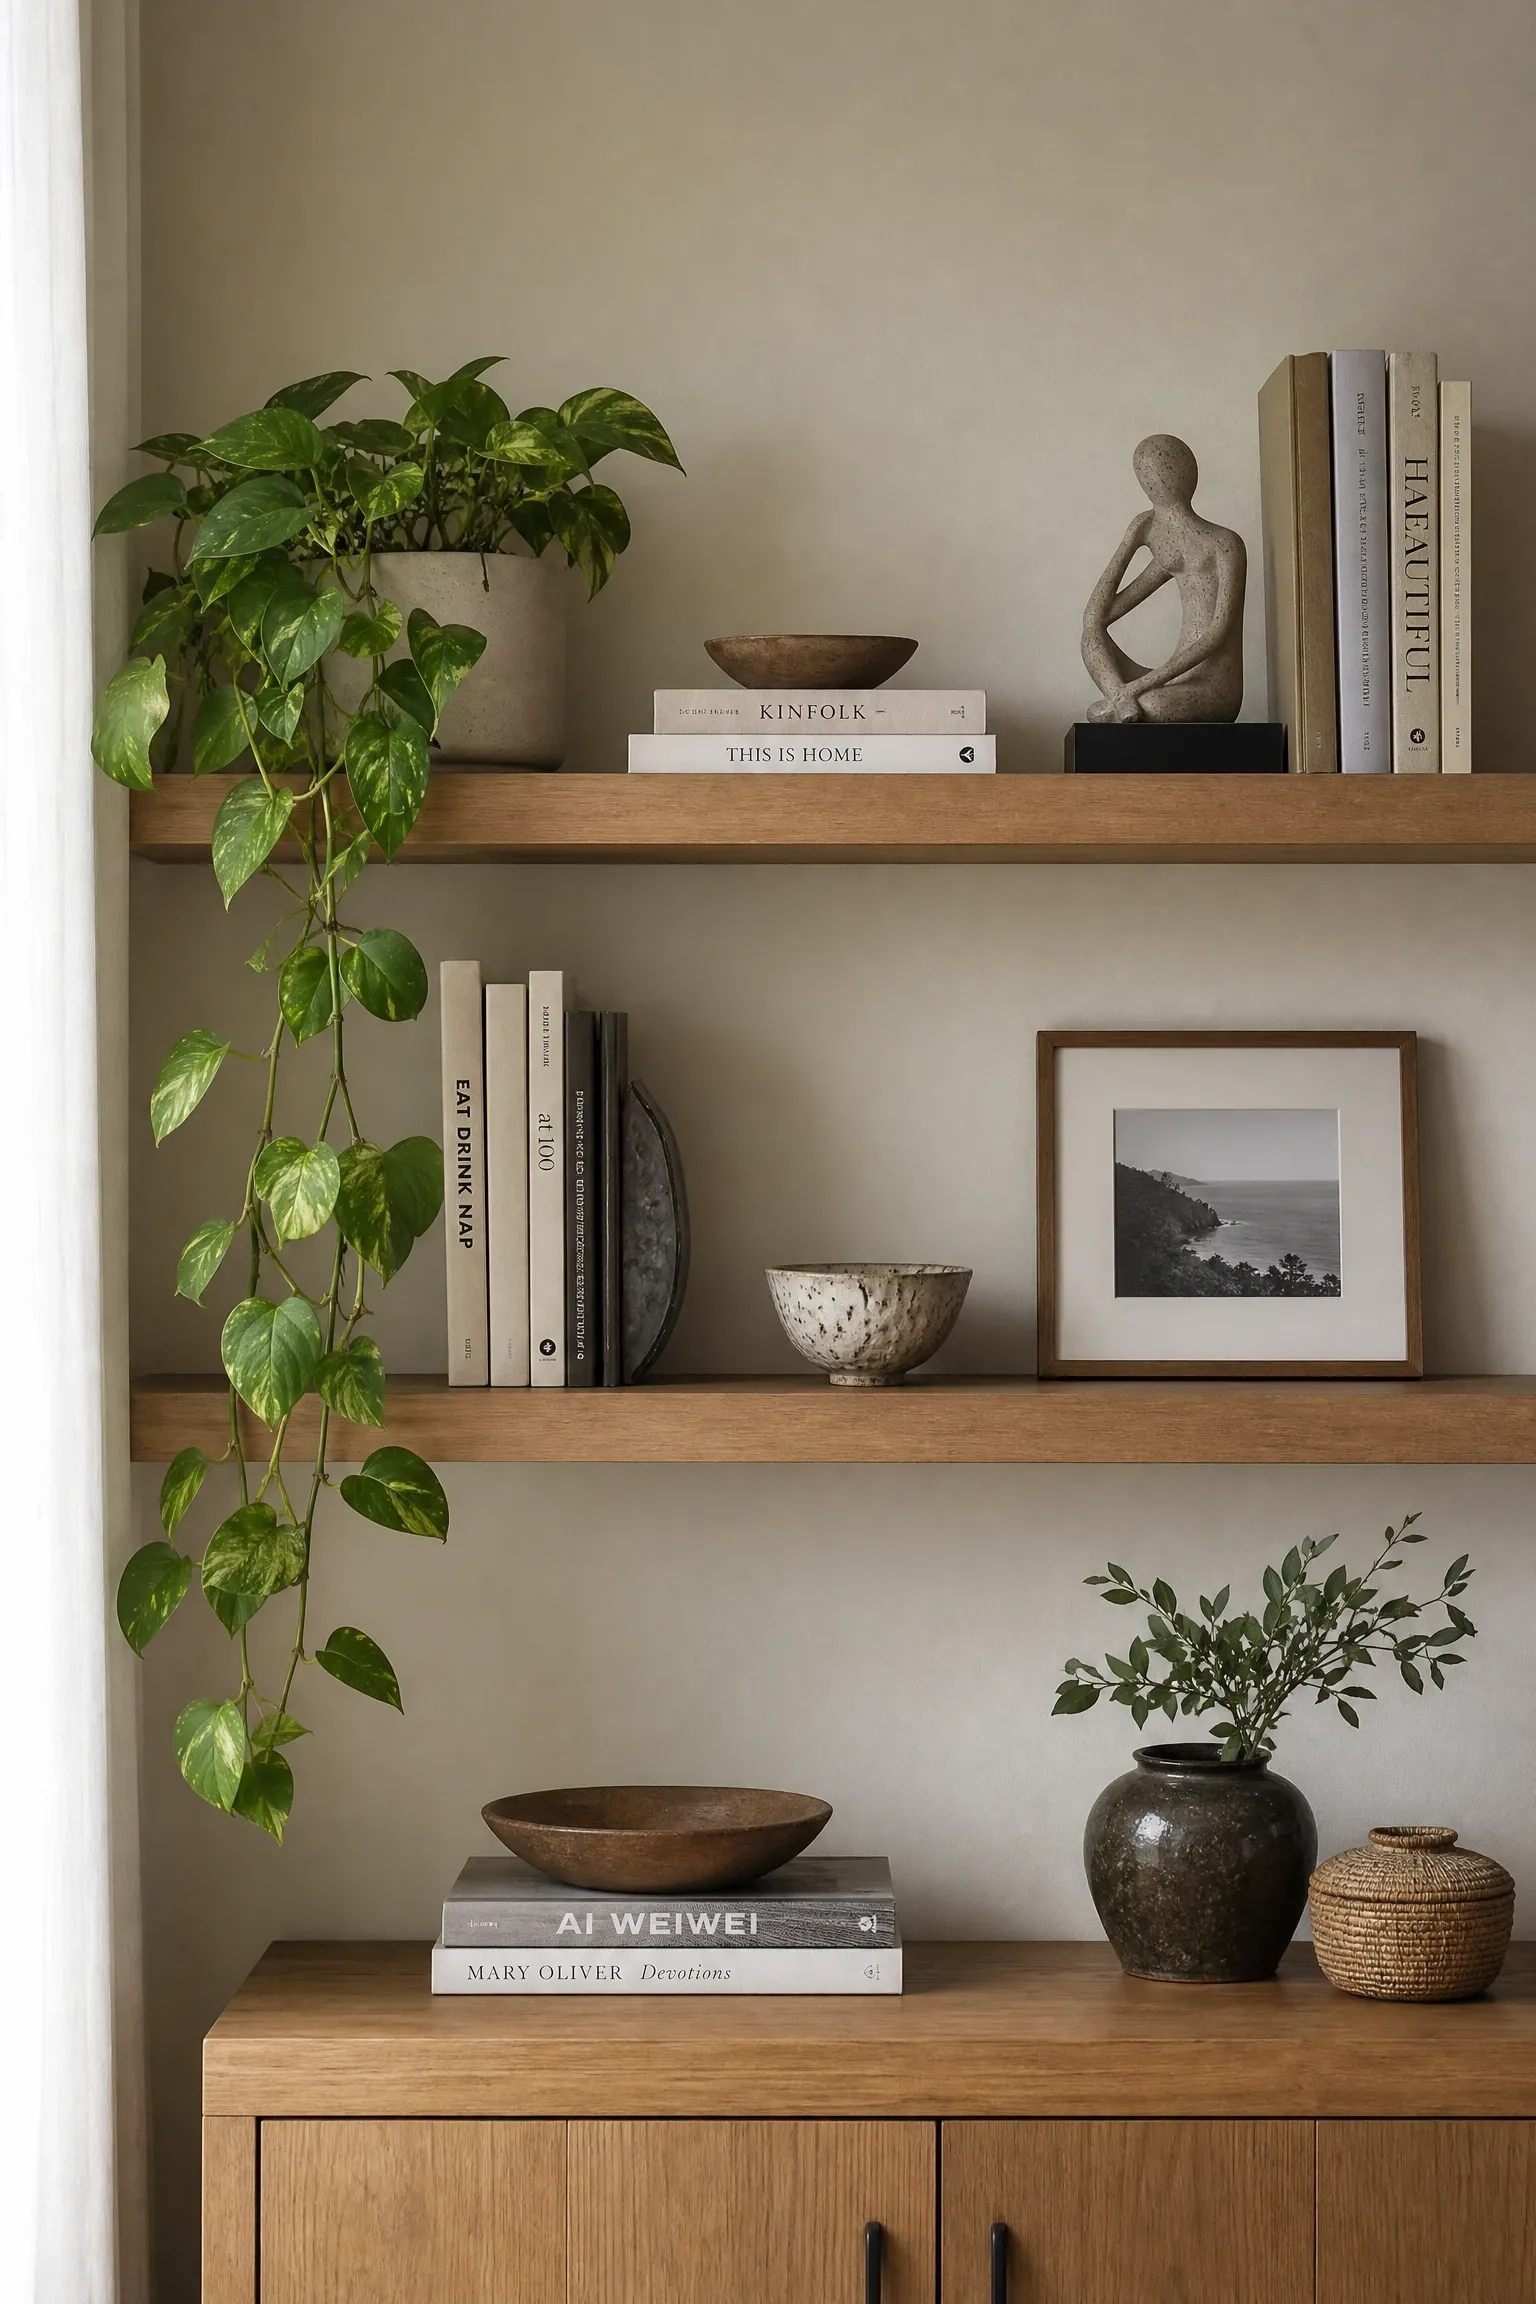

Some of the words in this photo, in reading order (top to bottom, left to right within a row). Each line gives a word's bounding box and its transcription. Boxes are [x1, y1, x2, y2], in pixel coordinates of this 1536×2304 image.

[1404, 457, 1431, 693] HAEAUTIFUL
[759, 704, 867, 720] KINFOLK
[726, 747, 772, 762] THIS
[778, 747, 796, 762] IS
[802, 747, 863, 762] HOME
[456, 1079, 471, 1118] EAT
[538, 1113, 554, 1132] at
[457, 1127, 473, 1195] DRINK
[538, 1138, 555, 1171] 100
[458, 1204, 474, 1249] NAP
[556, 1912, 594, 1935] AI
[610, 1912, 758, 1935] WEIWEI
[466, 1964, 531, 1981] MARY
[539, 1964, 623, 1981] OLIVER
[640, 1964, 732, 1981] Devotions
